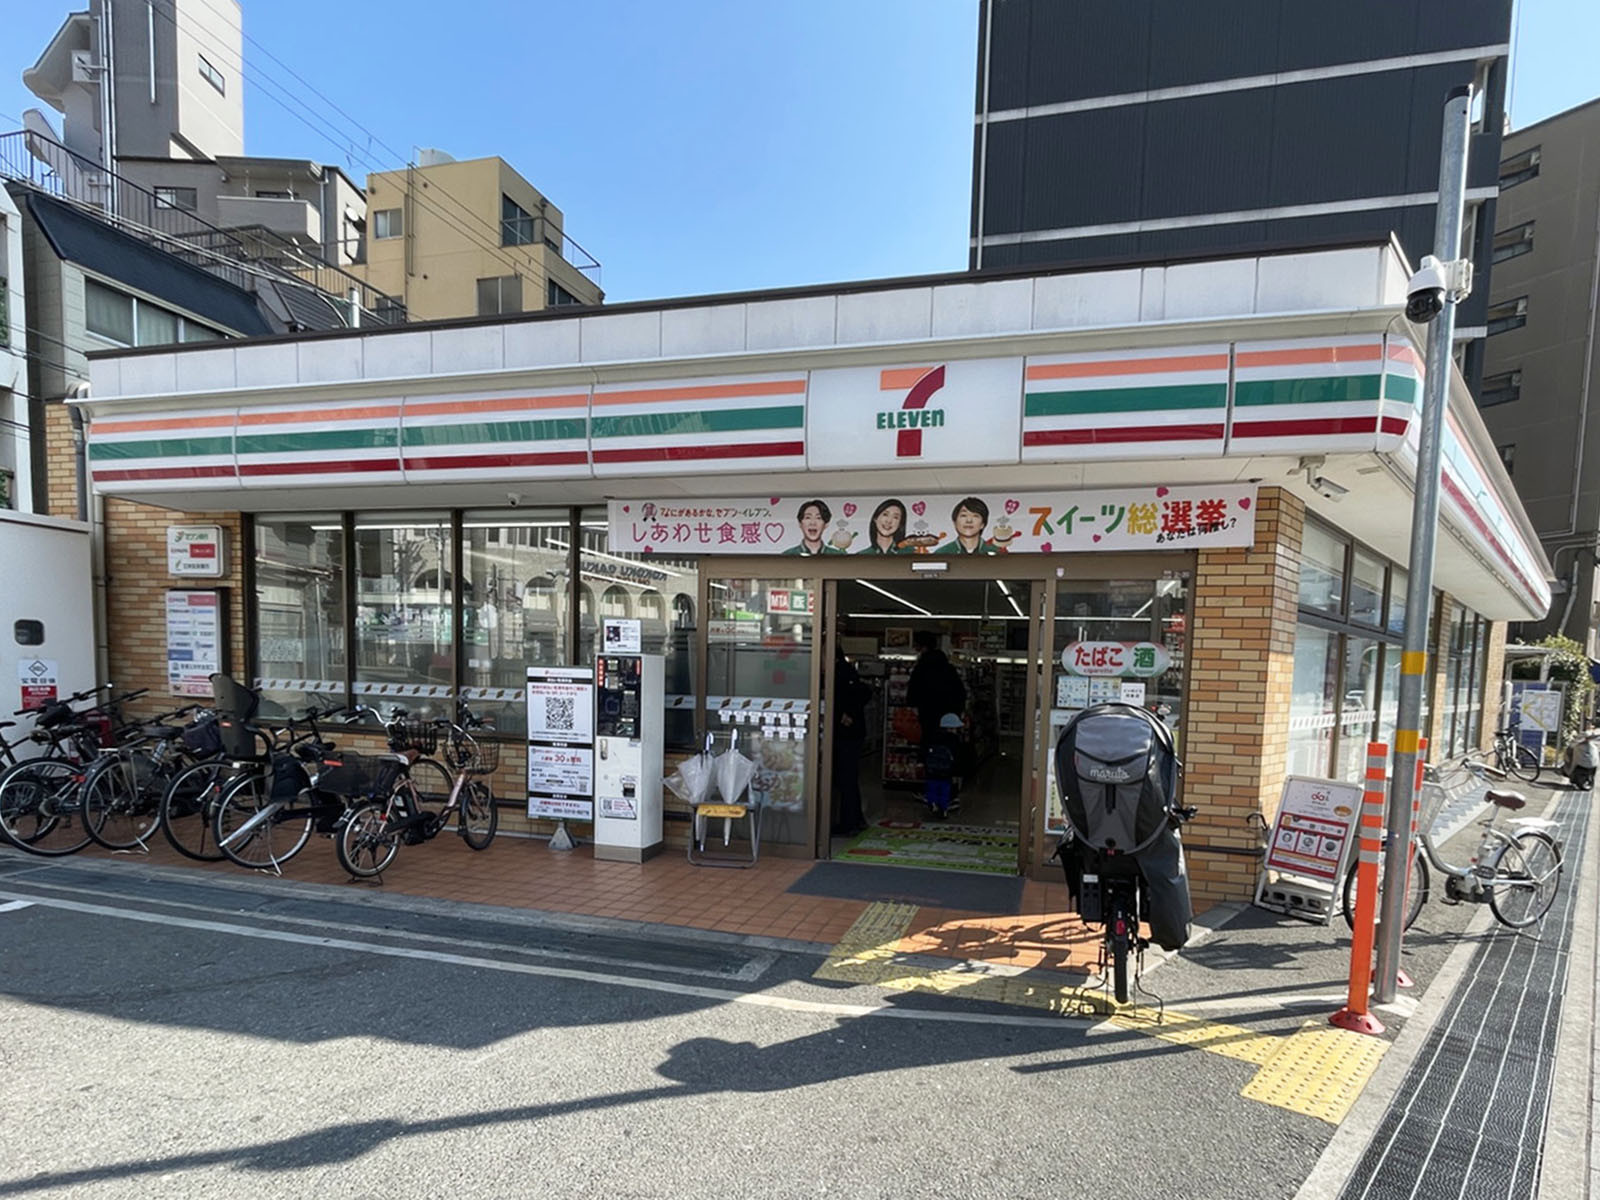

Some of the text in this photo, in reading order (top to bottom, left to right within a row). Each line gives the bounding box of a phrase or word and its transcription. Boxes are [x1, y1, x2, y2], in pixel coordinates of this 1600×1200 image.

[880, 365, 945, 457] 7
[1028, 498, 1228, 537] スイーツ総選挙
[1075, 646, 1124, 667] たばこ
[1133, 647, 1156, 668] 酒
